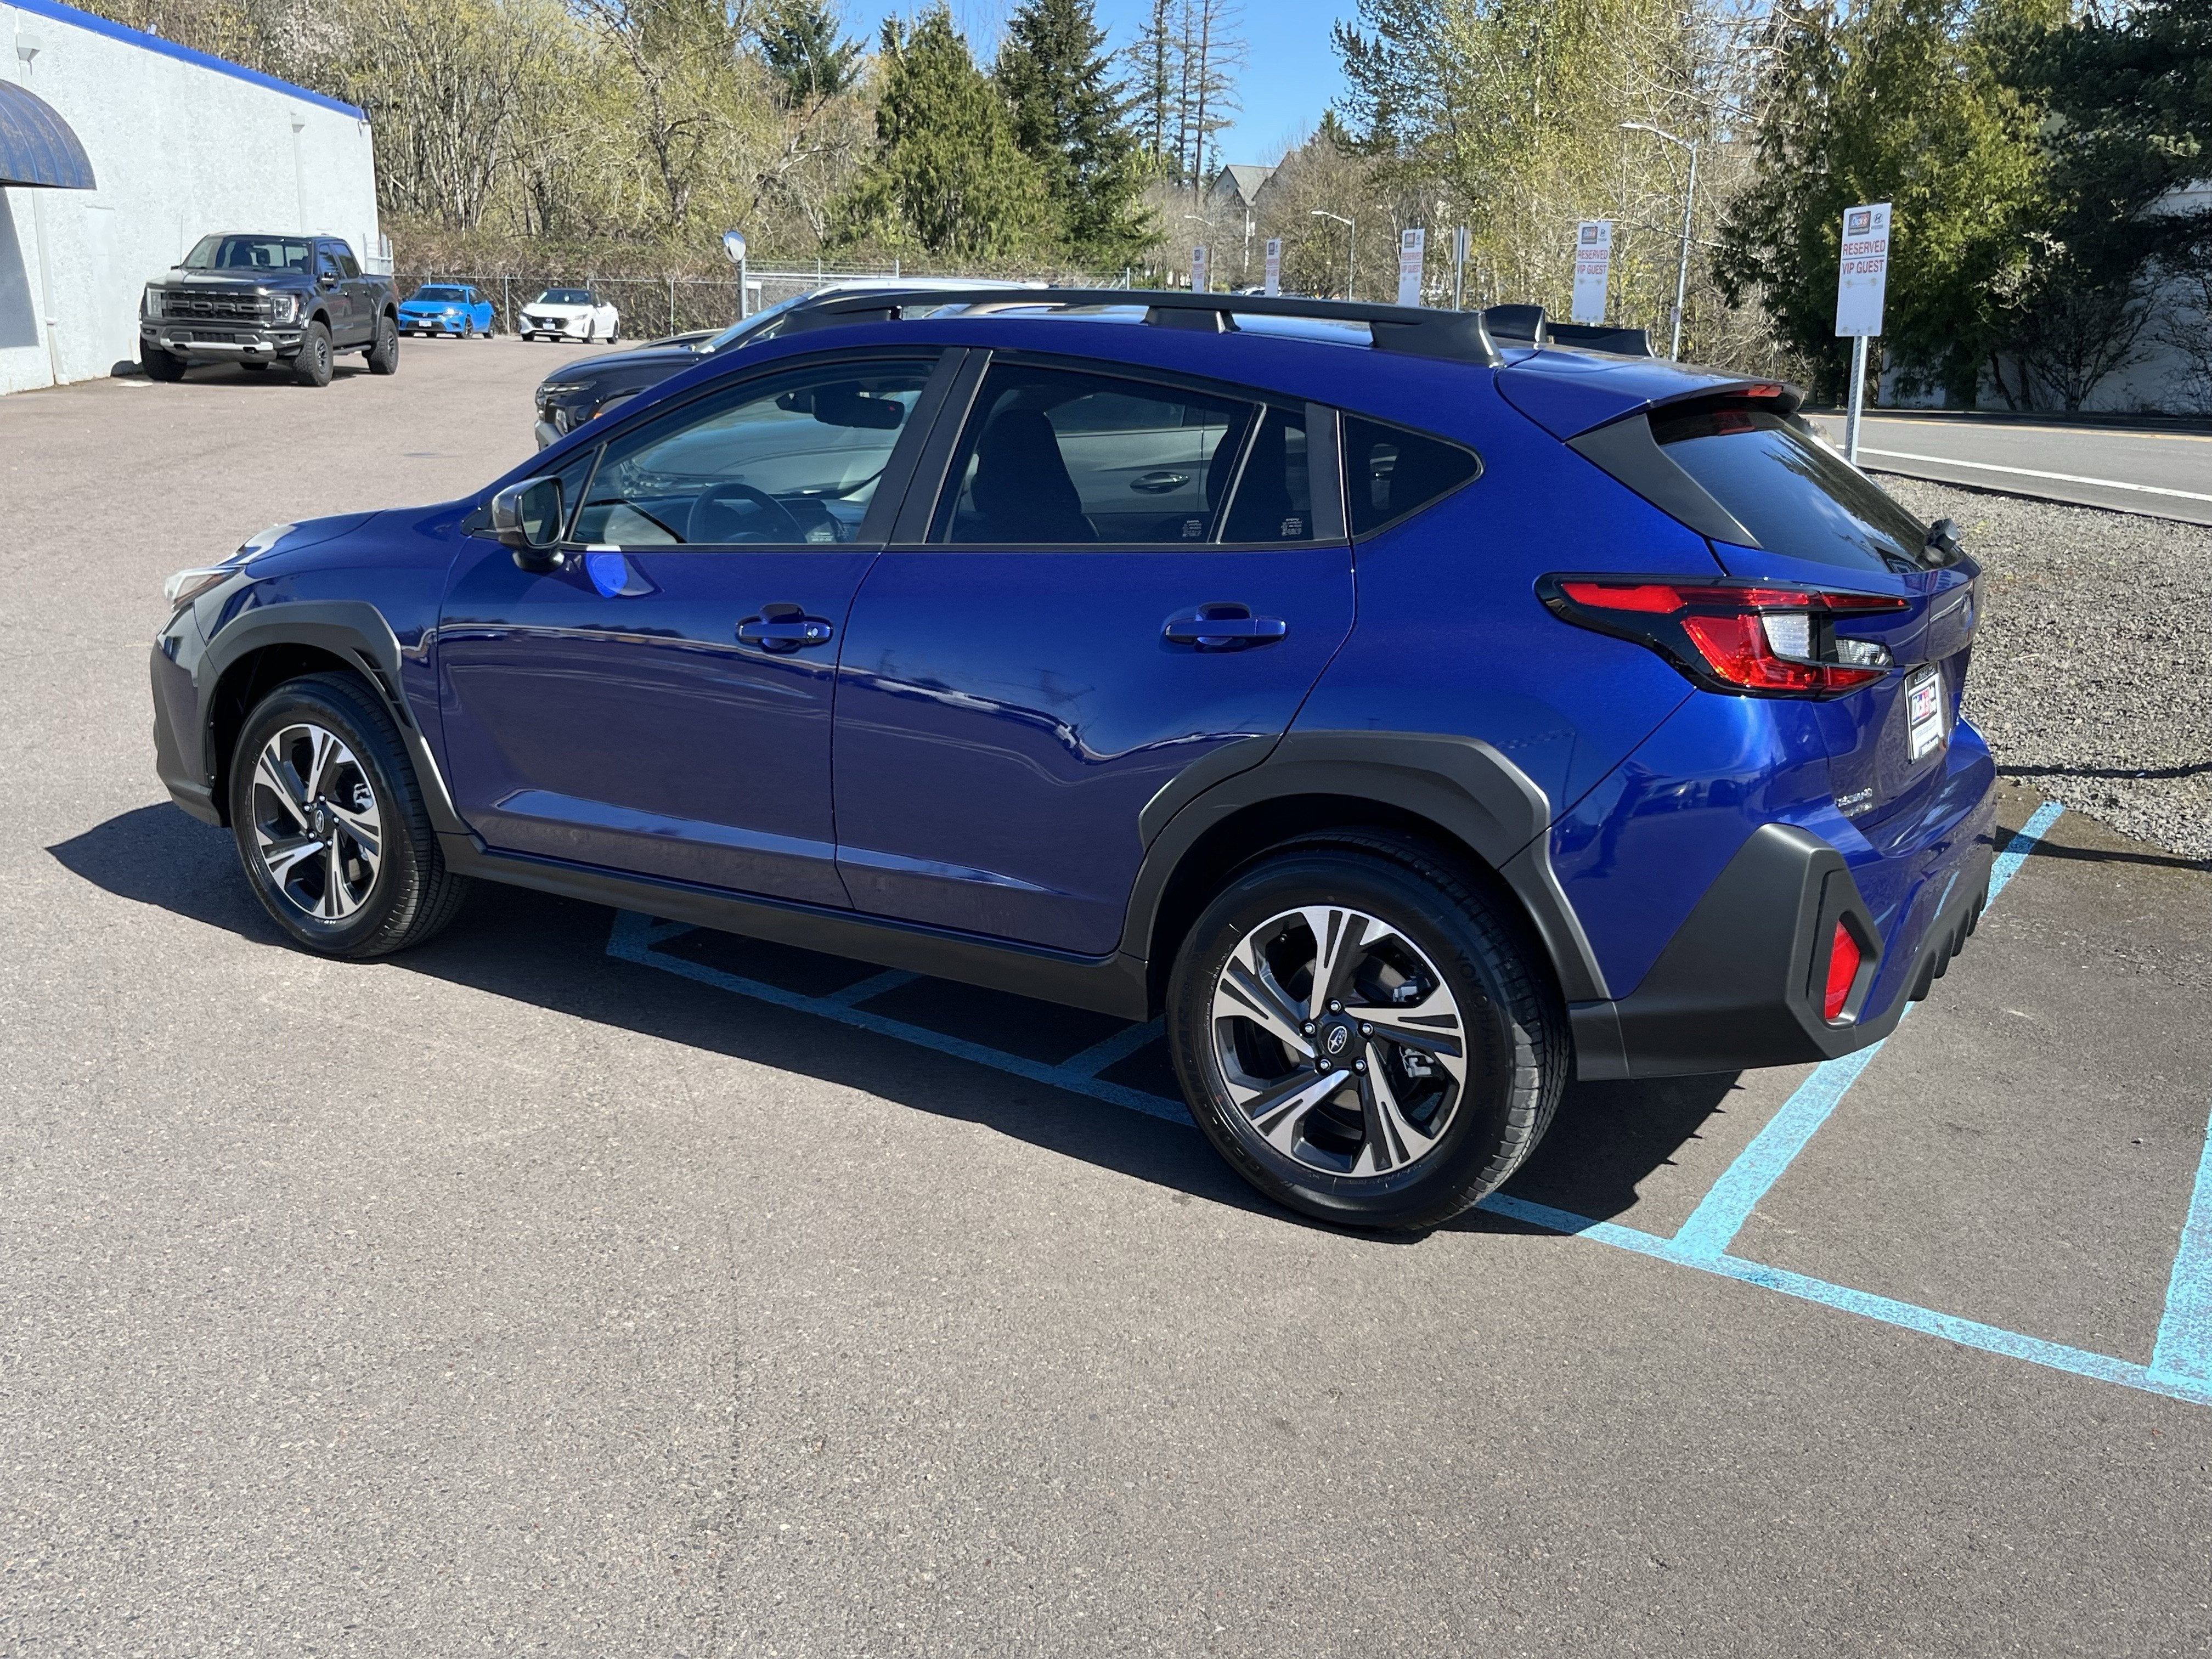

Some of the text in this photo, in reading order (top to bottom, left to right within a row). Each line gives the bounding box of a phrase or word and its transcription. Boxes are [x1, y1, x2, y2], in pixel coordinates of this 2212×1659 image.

[1578, 250, 1608, 259] RESERVED
[1843, 240, 1886, 256] RESERVED
[1577, 264, 1607, 274] VIP GUEST
[1842, 259, 1884, 275] VIP GUEST
[169, 300, 261, 313] FORD
